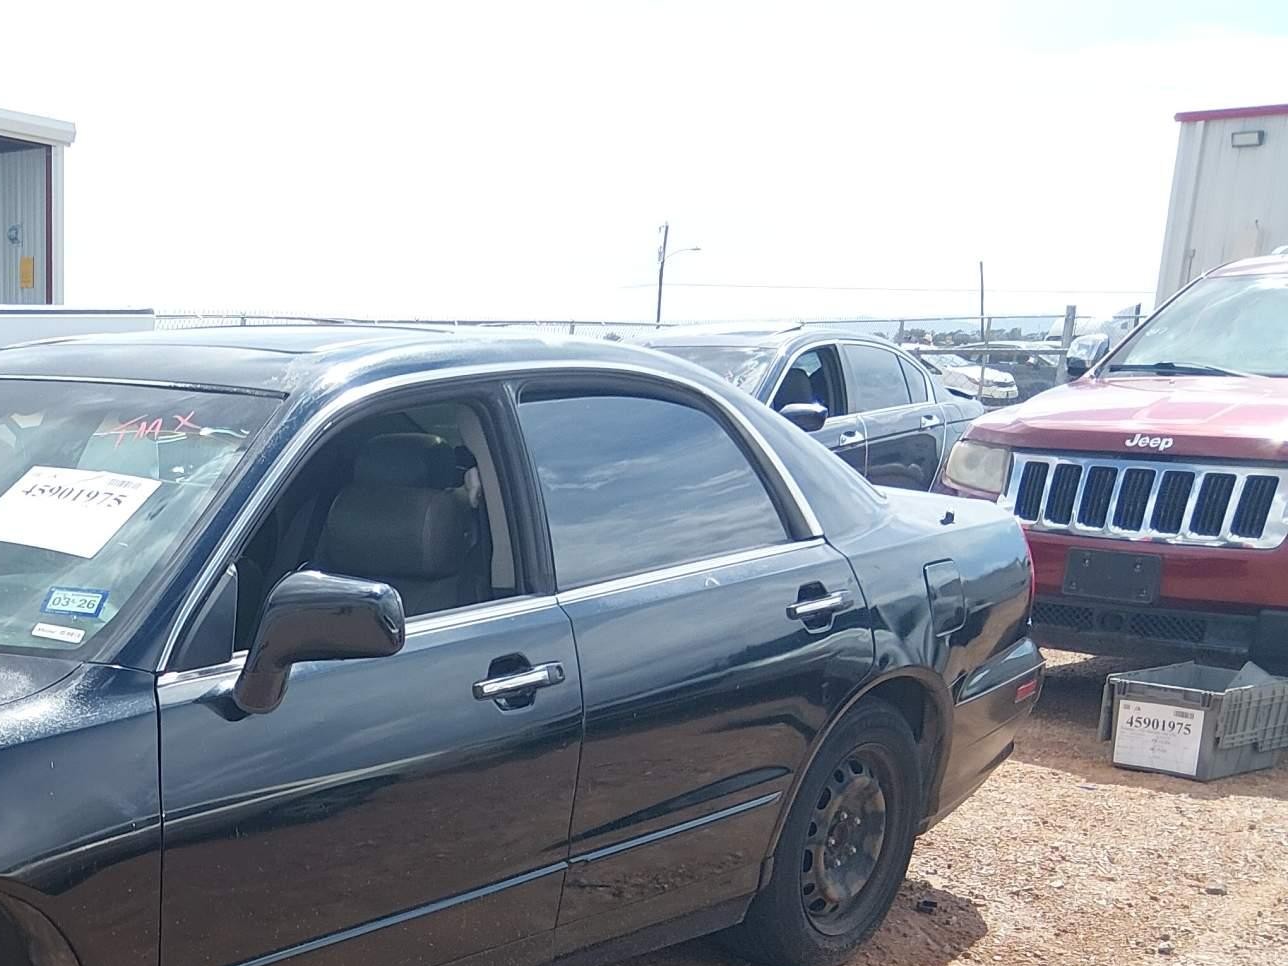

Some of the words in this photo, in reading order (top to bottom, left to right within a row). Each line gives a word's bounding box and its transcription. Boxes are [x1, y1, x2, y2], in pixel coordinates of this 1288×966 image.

[1125, 433, 1173, 451] Jeep
[22, 484, 127, 507] 45901975
[1126, 716, 1191, 736] 45901975
